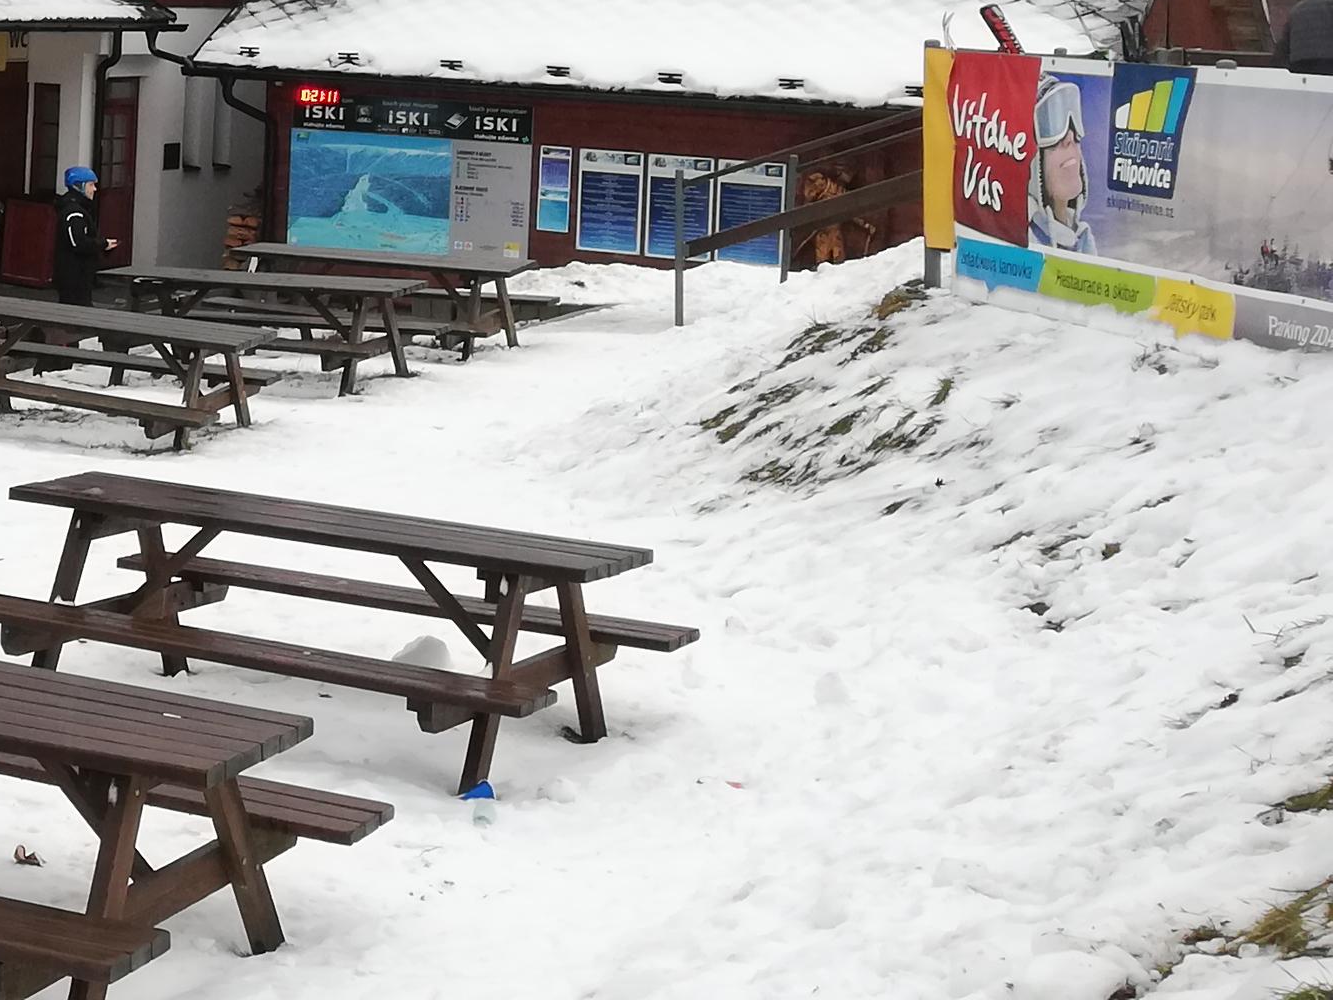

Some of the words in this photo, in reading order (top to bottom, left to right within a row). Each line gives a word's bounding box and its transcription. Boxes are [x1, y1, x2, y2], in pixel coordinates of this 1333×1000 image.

[9, 31, 29, 48] WC
[305, 105, 344, 121] iSKI
[388, 109, 429, 126] iSKI
[475, 115, 517, 132] iSKI
[1113, 131, 1175, 163] Skipark
[1112, 157, 1172, 189] Filipovice
[1268, 315, 1310, 346] Parking
